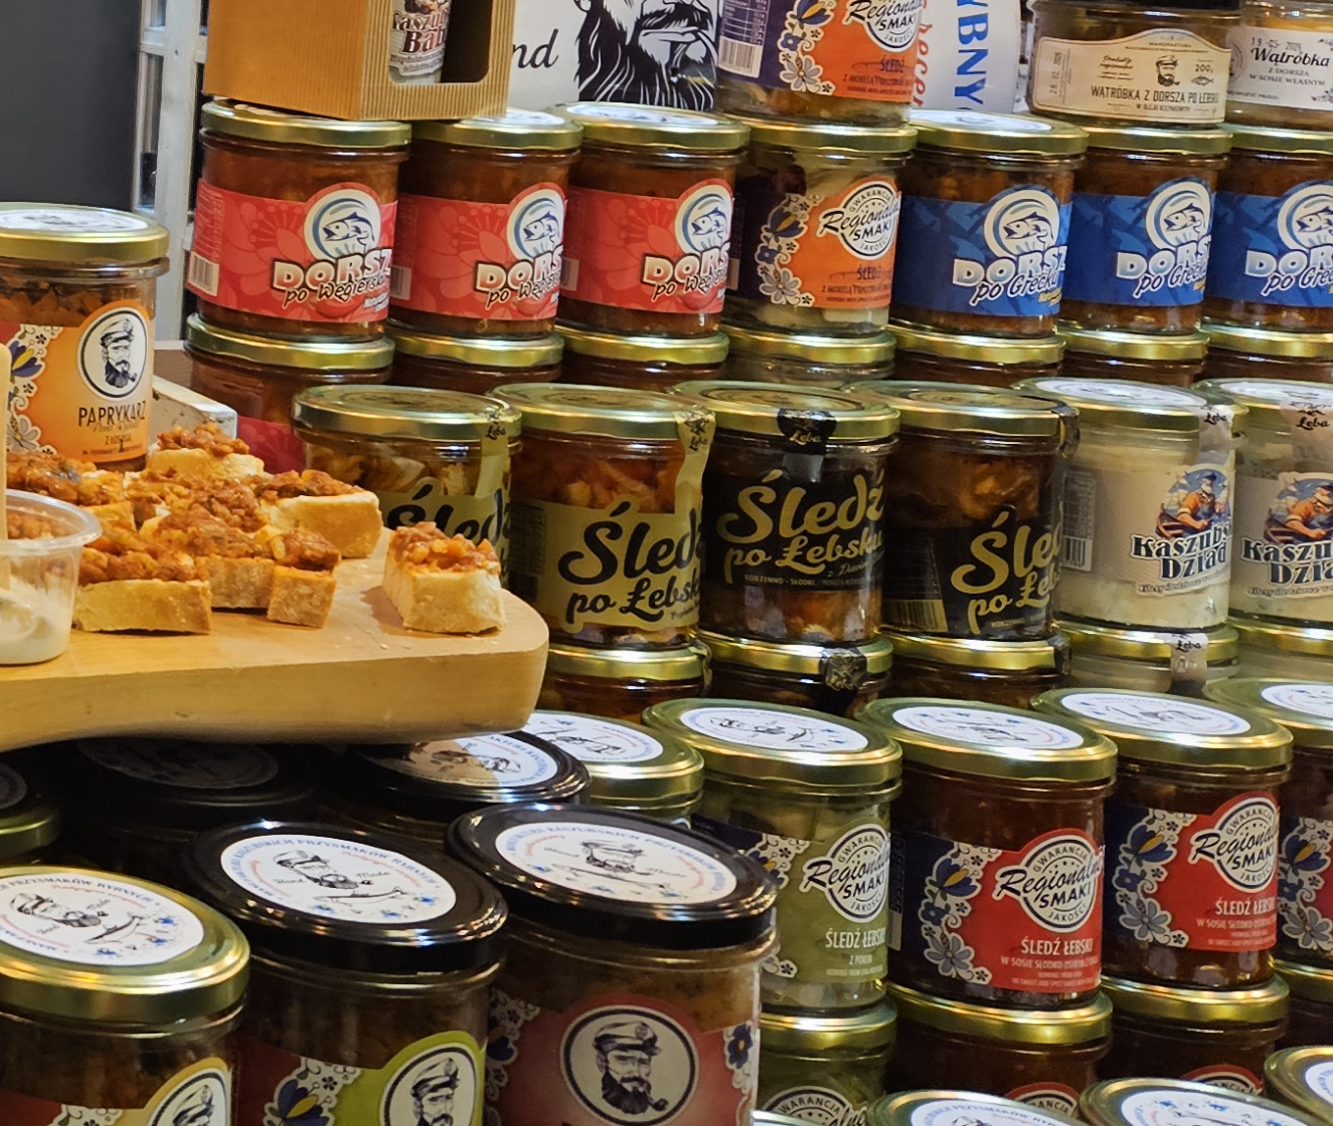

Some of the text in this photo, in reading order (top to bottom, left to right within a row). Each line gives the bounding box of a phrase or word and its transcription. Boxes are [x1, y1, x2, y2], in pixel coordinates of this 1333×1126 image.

[512, 28, 560, 70] nd
[1250, 46, 1331, 68] Wątróbka
[1258, 74, 1282, 83] SOSIE
[1285, 78, 1325, 86] WŁASNYM
[1276, 68, 1310, 77] DORSZA
[1090, 85, 1141, 101] WĄTRÓBKA
[1144, 91, 1149, 101] Z
[1153, 90, 1185, 103] DORSZA
[1188, 92, 1196, 103] PO
[272, 247, 393, 290] DORSZ
[953, 245, 1068, 287] DORSZ
[652, 282, 677, 302] po
[970, 273, 1060, 307] po Grecku
[1134, 274, 1167, 298] po
[1261, 273, 1298, 297] po
[282, 288, 309, 309] po
[486, 287, 511, 309] po
[78, 400, 147, 428] PAPRYKARZ
[1203, 413, 1228, 425] Łeba
[1295, 416, 1330, 431] Łeba
[104, 435, 110, 445] Z
[789, 430, 822, 446] Łeba
[716, 469, 884, 544] Śledź
[724, 545, 771, 584] po
[775, 525, 883, 575] Łebsku
[1160, 543, 1227, 581] Dziad
[566, 590, 616, 624] po
[968, 594, 1013, 635] po
[1175, 640, 1201, 653] Łeba
[1033, 846, 1088, 873] GWARANCJA
[1039, 882, 1091, 909] SMAKI
[1215, 897, 1252, 915] ŚLEDŹ
[1047, 903, 1087, 923] JAKOŚCI
[825, 927, 860, 949] ŚLEDŹ
[1021, 936, 1060, 956] ŚLEDŹ
[1001, 955, 1033, 967] W SOSIE
[777, 1095, 843, 1117] WARANCJA
